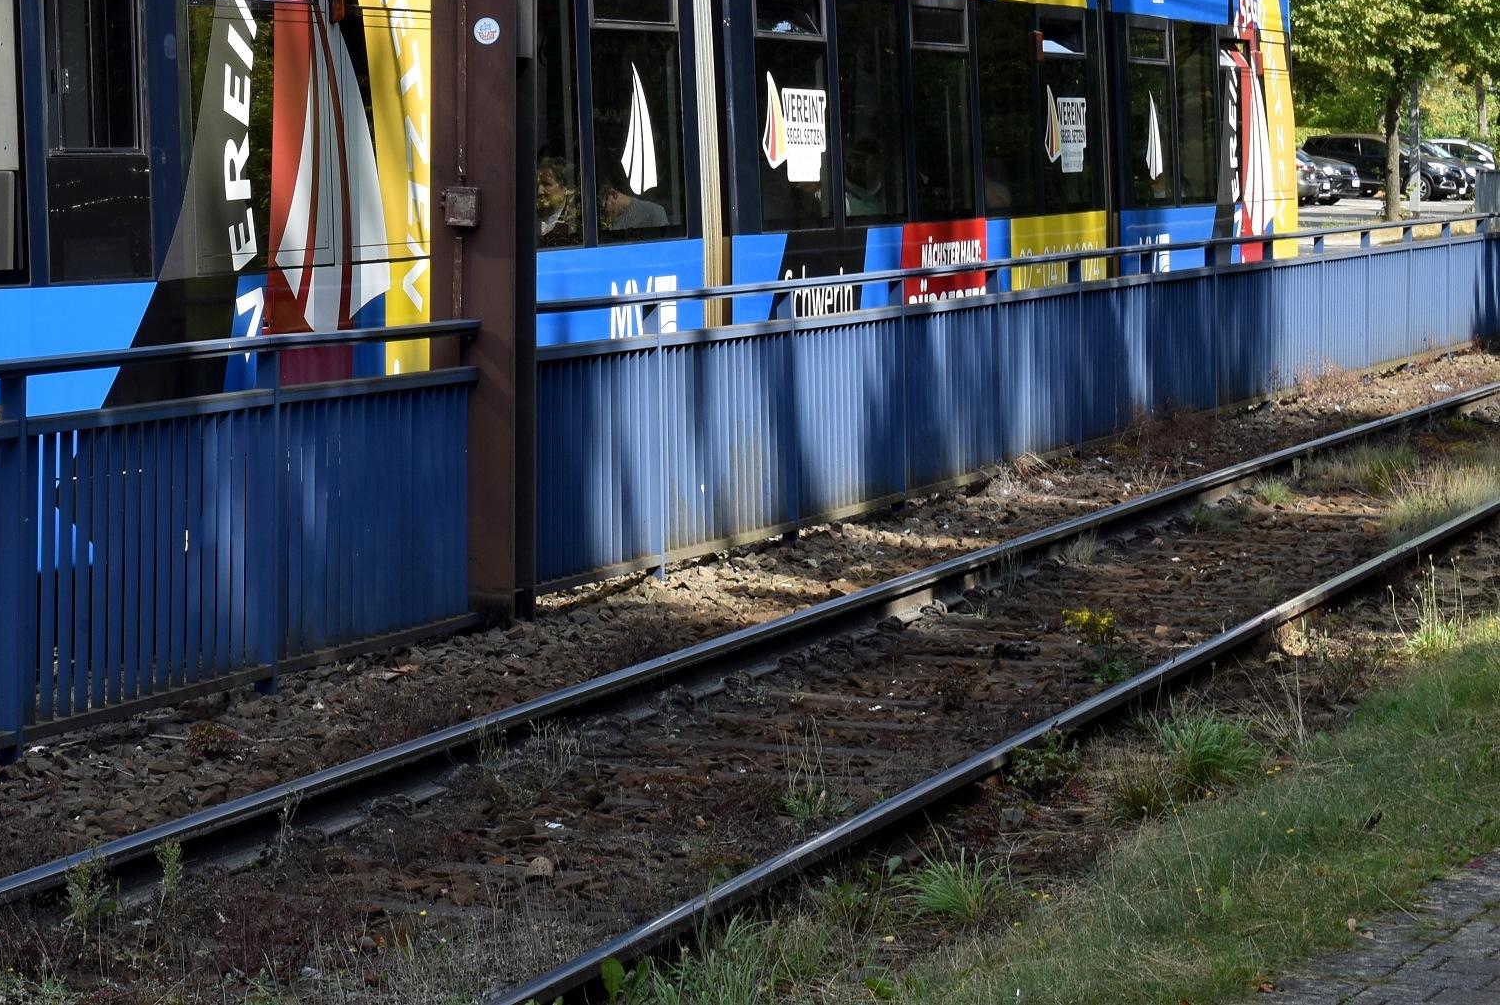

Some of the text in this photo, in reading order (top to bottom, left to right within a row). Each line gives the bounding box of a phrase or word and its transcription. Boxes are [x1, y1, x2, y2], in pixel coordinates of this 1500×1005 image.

[783, 93, 825, 125] VEREINT
[1058, 101, 1086, 126] VEREINT
[787, 127, 825, 146] SEGEL SETZEN
[921, 235, 960, 269] NÄCHSTER
